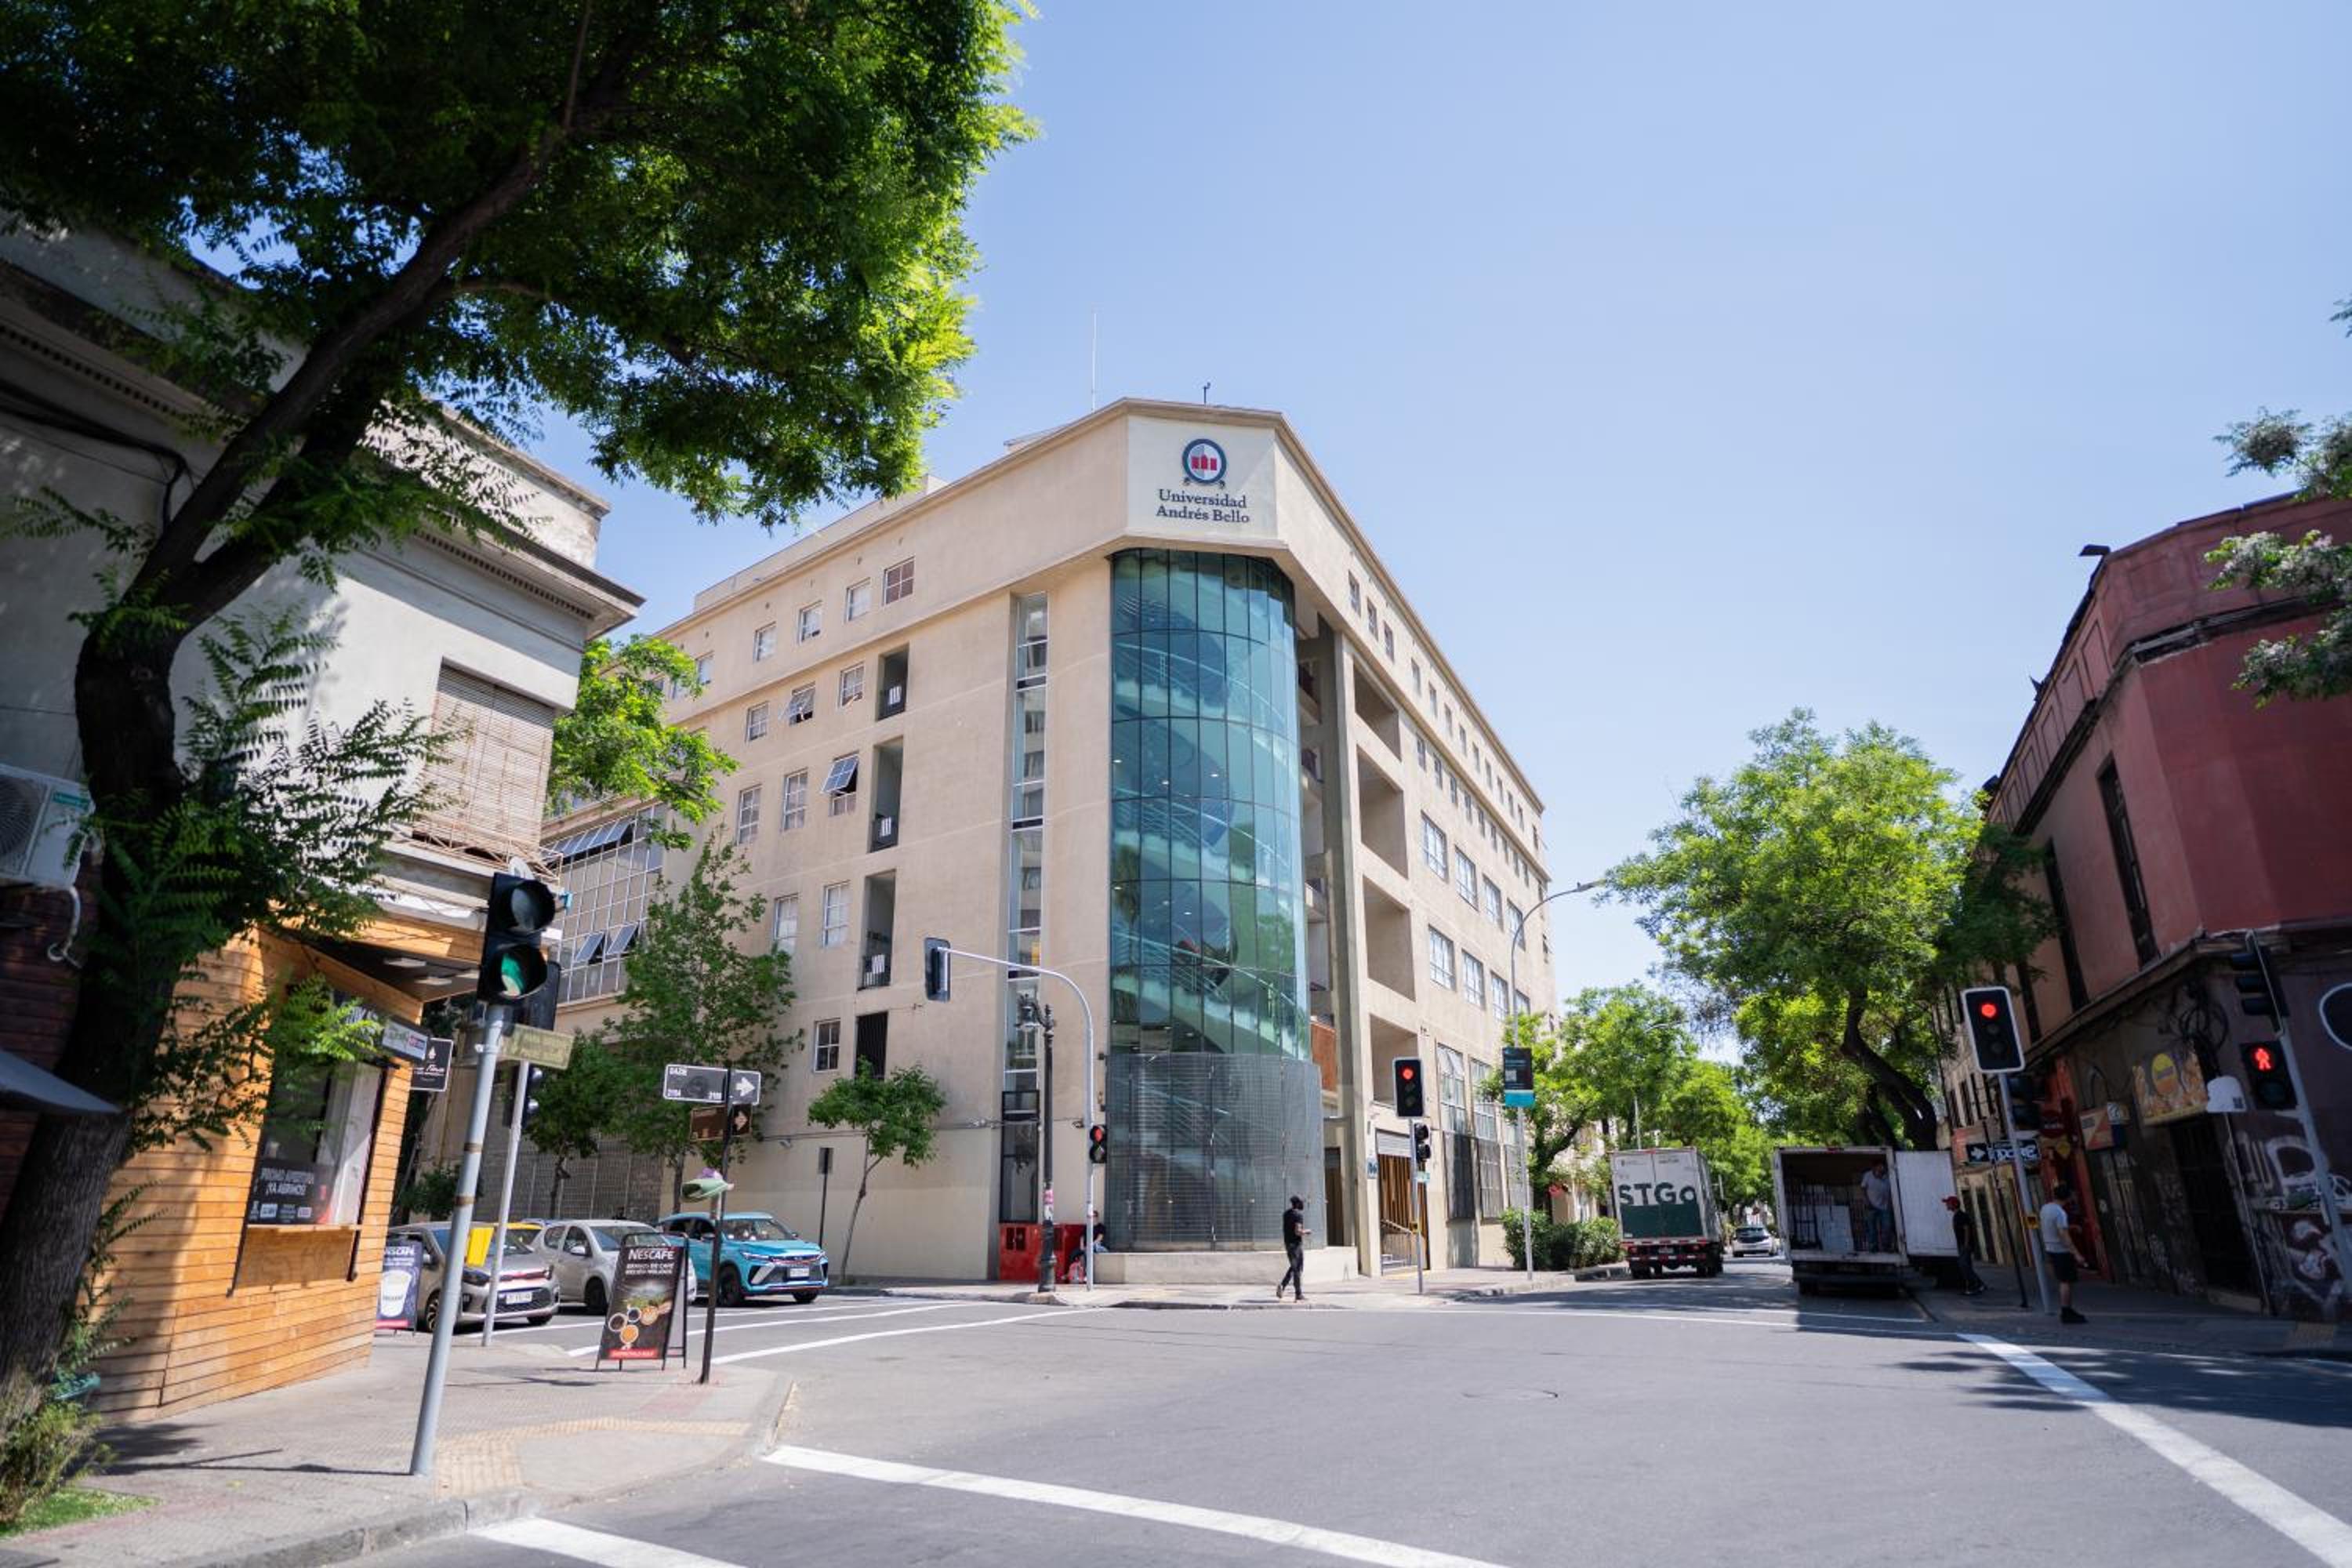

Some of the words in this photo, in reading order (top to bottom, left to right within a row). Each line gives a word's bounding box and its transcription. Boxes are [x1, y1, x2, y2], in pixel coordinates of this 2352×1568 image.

[1159, 488, 1247, 508] Universidad
[1156, 504, 1209, 521] Andrés
[1213, 510, 1250, 523] Bello
